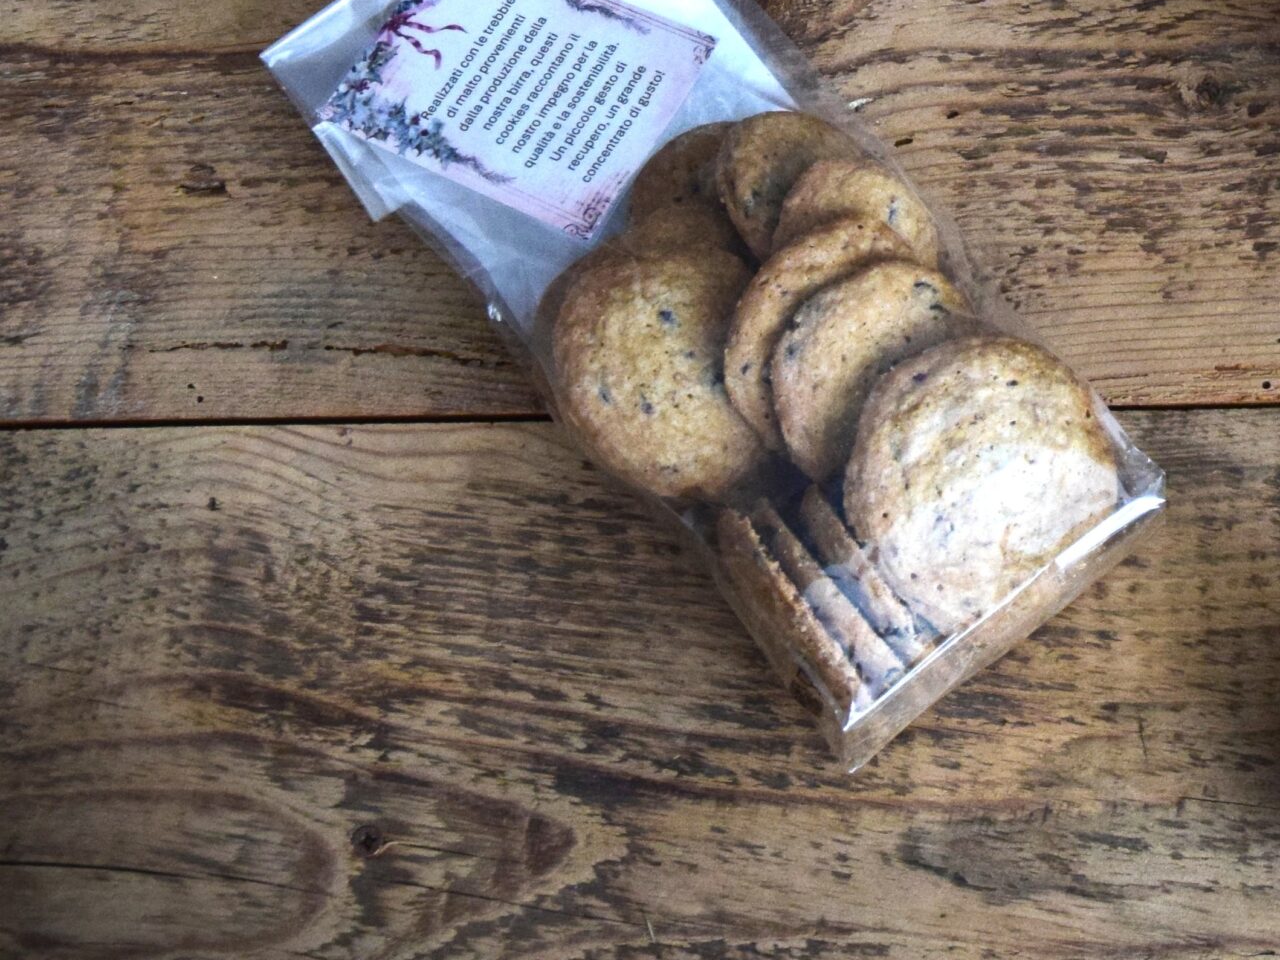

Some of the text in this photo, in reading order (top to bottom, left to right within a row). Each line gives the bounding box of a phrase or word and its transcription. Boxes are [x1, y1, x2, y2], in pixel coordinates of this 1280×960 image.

[419, 69, 464, 120] Realizzati
[460, 48, 479, 68] con
[455, 74, 482, 106] malto
[479, 15, 526, 75] provenienti
[459, 17, 547, 132] dalla produzione della
[483, 32, 558, 131] nostra birra, questi
[496, 103, 530, 145] cookies
[526, 43, 574, 103] raccontano
[512, 119, 541, 154] nostro
[538, 72, 575, 118] impegno
[572, 52, 589, 72] per
[524, 131, 556, 168] qualità
[567, 43, 619, 110] sostenibilità.
[564, 105, 597, 146] piccolo
[594, 75, 618, 105] gesto
[567, 122, 610, 171] recupero,
[617, 66, 646, 105] grande
[582, 119, 632, 183] concentrato
[638, 70, 665, 107] gusto!
